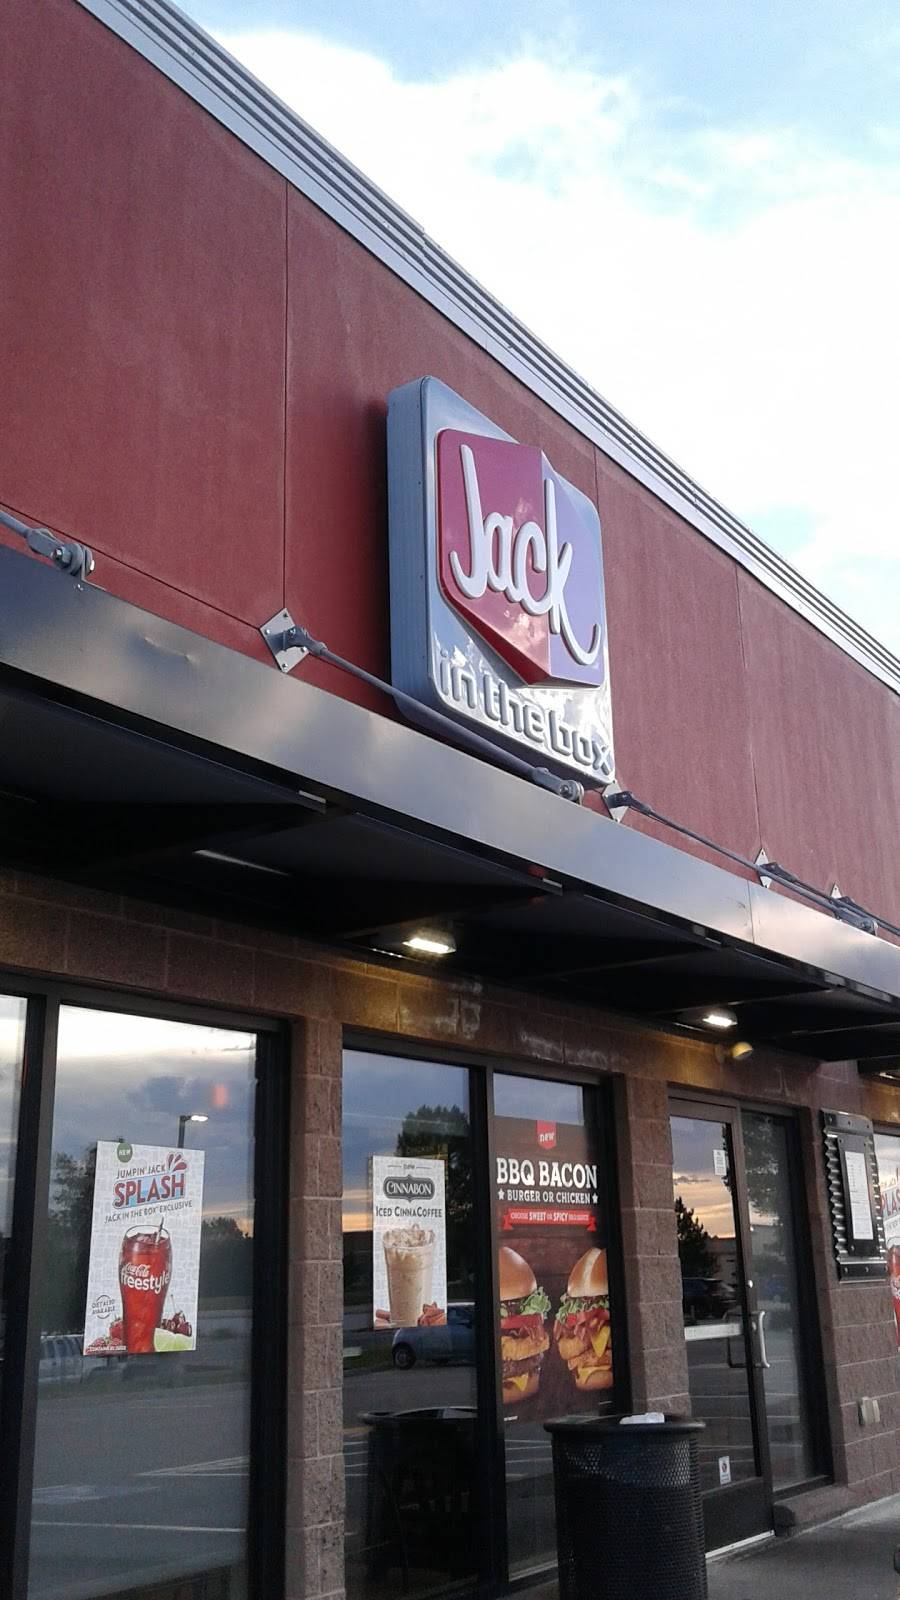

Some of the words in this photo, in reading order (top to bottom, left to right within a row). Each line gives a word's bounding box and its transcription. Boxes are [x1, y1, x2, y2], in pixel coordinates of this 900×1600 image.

[449, 444, 601, 666] Jack
[439, 650, 476, 709] in
[483, 674, 545, 742] the
[547, 709, 613, 776] box
[148, 1164, 166, 1175] JACK
[496, 1157, 535, 1186] BBQ
[538, 1160, 598, 1189] BACON
[114, 1173, 185, 1208] SPLASH
[386, 1180, 432, 1195] CINNABON
[506, 1189, 541, 1202] BURGER
[542, 1190, 554, 1203] OR
[556, 1191, 591, 1205] CHICKEN
[104, 1213, 121, 1224] JACK
[122, 1211, 129, 1219] IN
[130, 1208, 142, 1218] THE
[160, 1200, 193, 1213] EXCLUSIVE
[375, 1205, 393, 1217] ICED
[529, 1211, 546, 1221] SWEET
[553, 1212, 568, 1222] SPICY
[120, 1268, 171, 1294] freestyle
